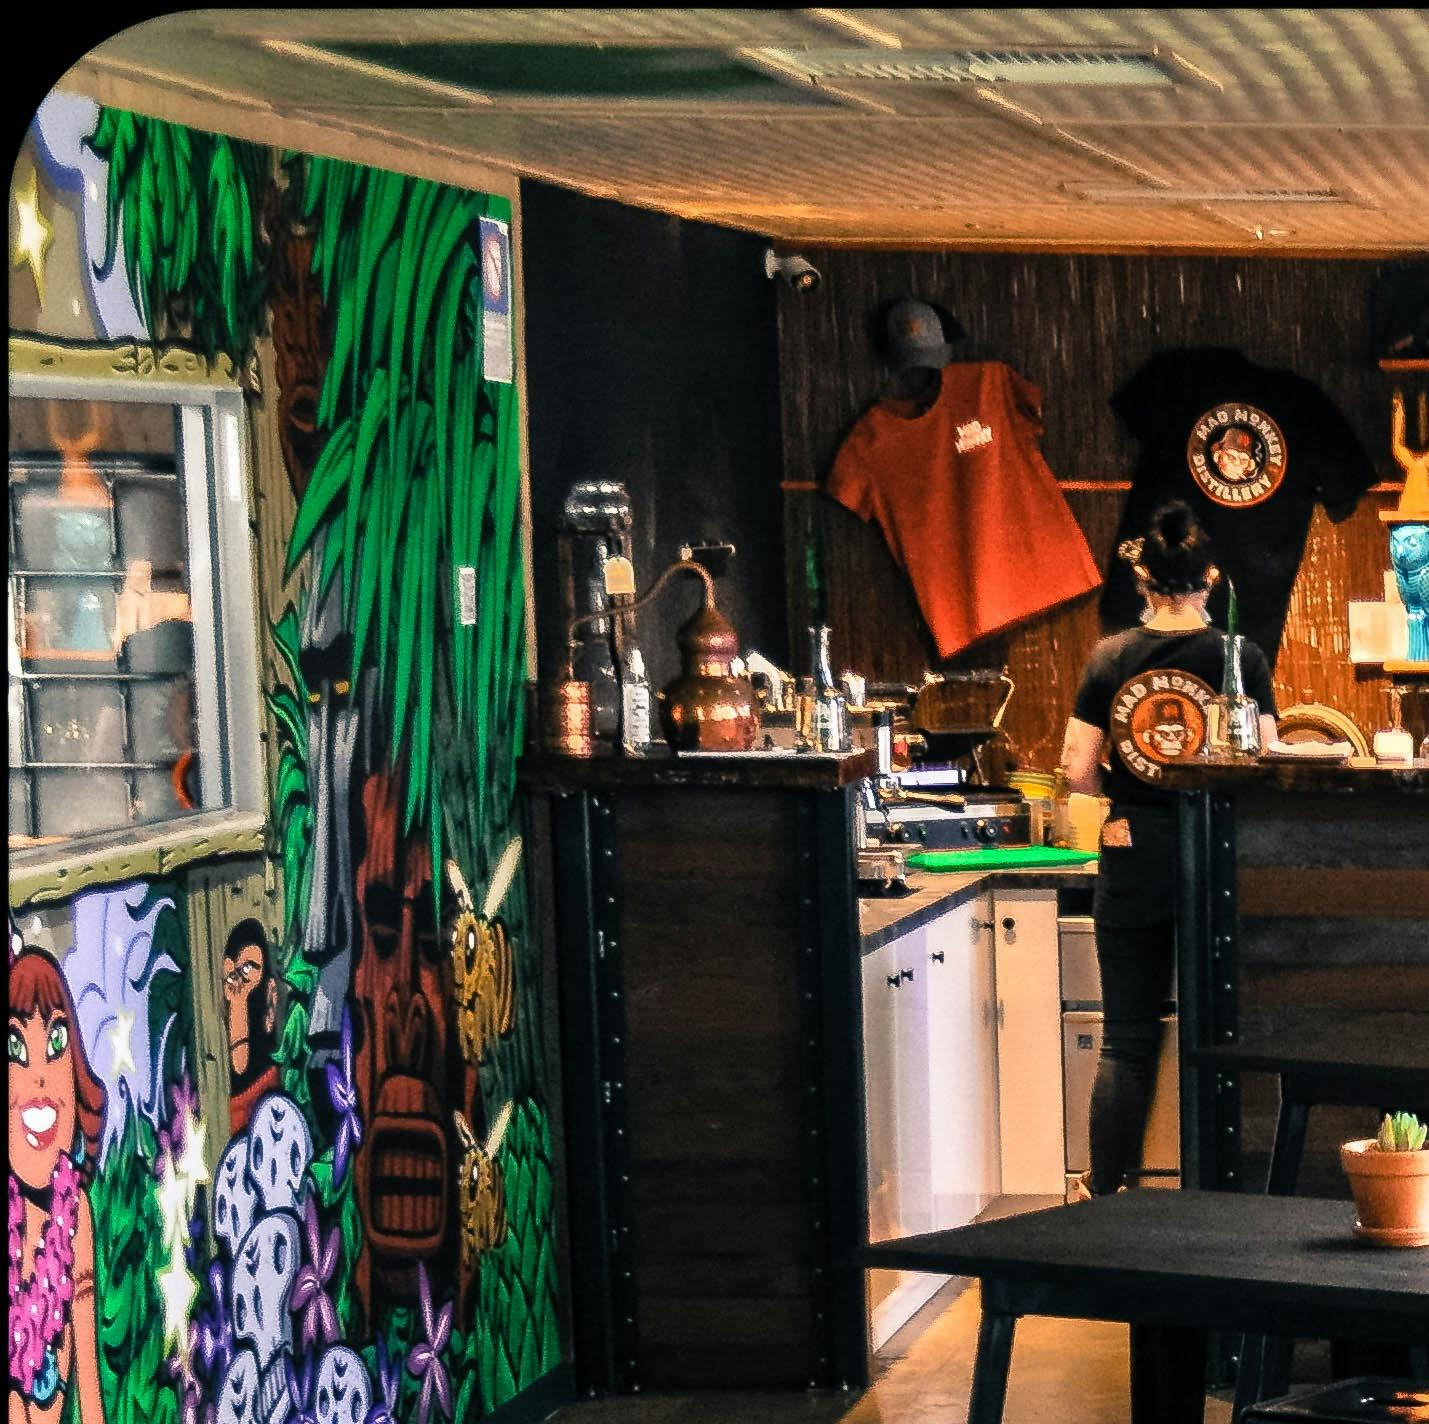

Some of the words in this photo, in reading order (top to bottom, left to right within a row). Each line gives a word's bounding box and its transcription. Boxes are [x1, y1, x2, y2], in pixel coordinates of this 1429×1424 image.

[1196, 410, 1229, 440] MAD
[1235, 408, 1282, 466] MONKEY
[1192, 454, 1272, 501] DISTILLERY
[1115, 683, 1148, 723] MAD
[1152, 675, 1209, 714] MONK
